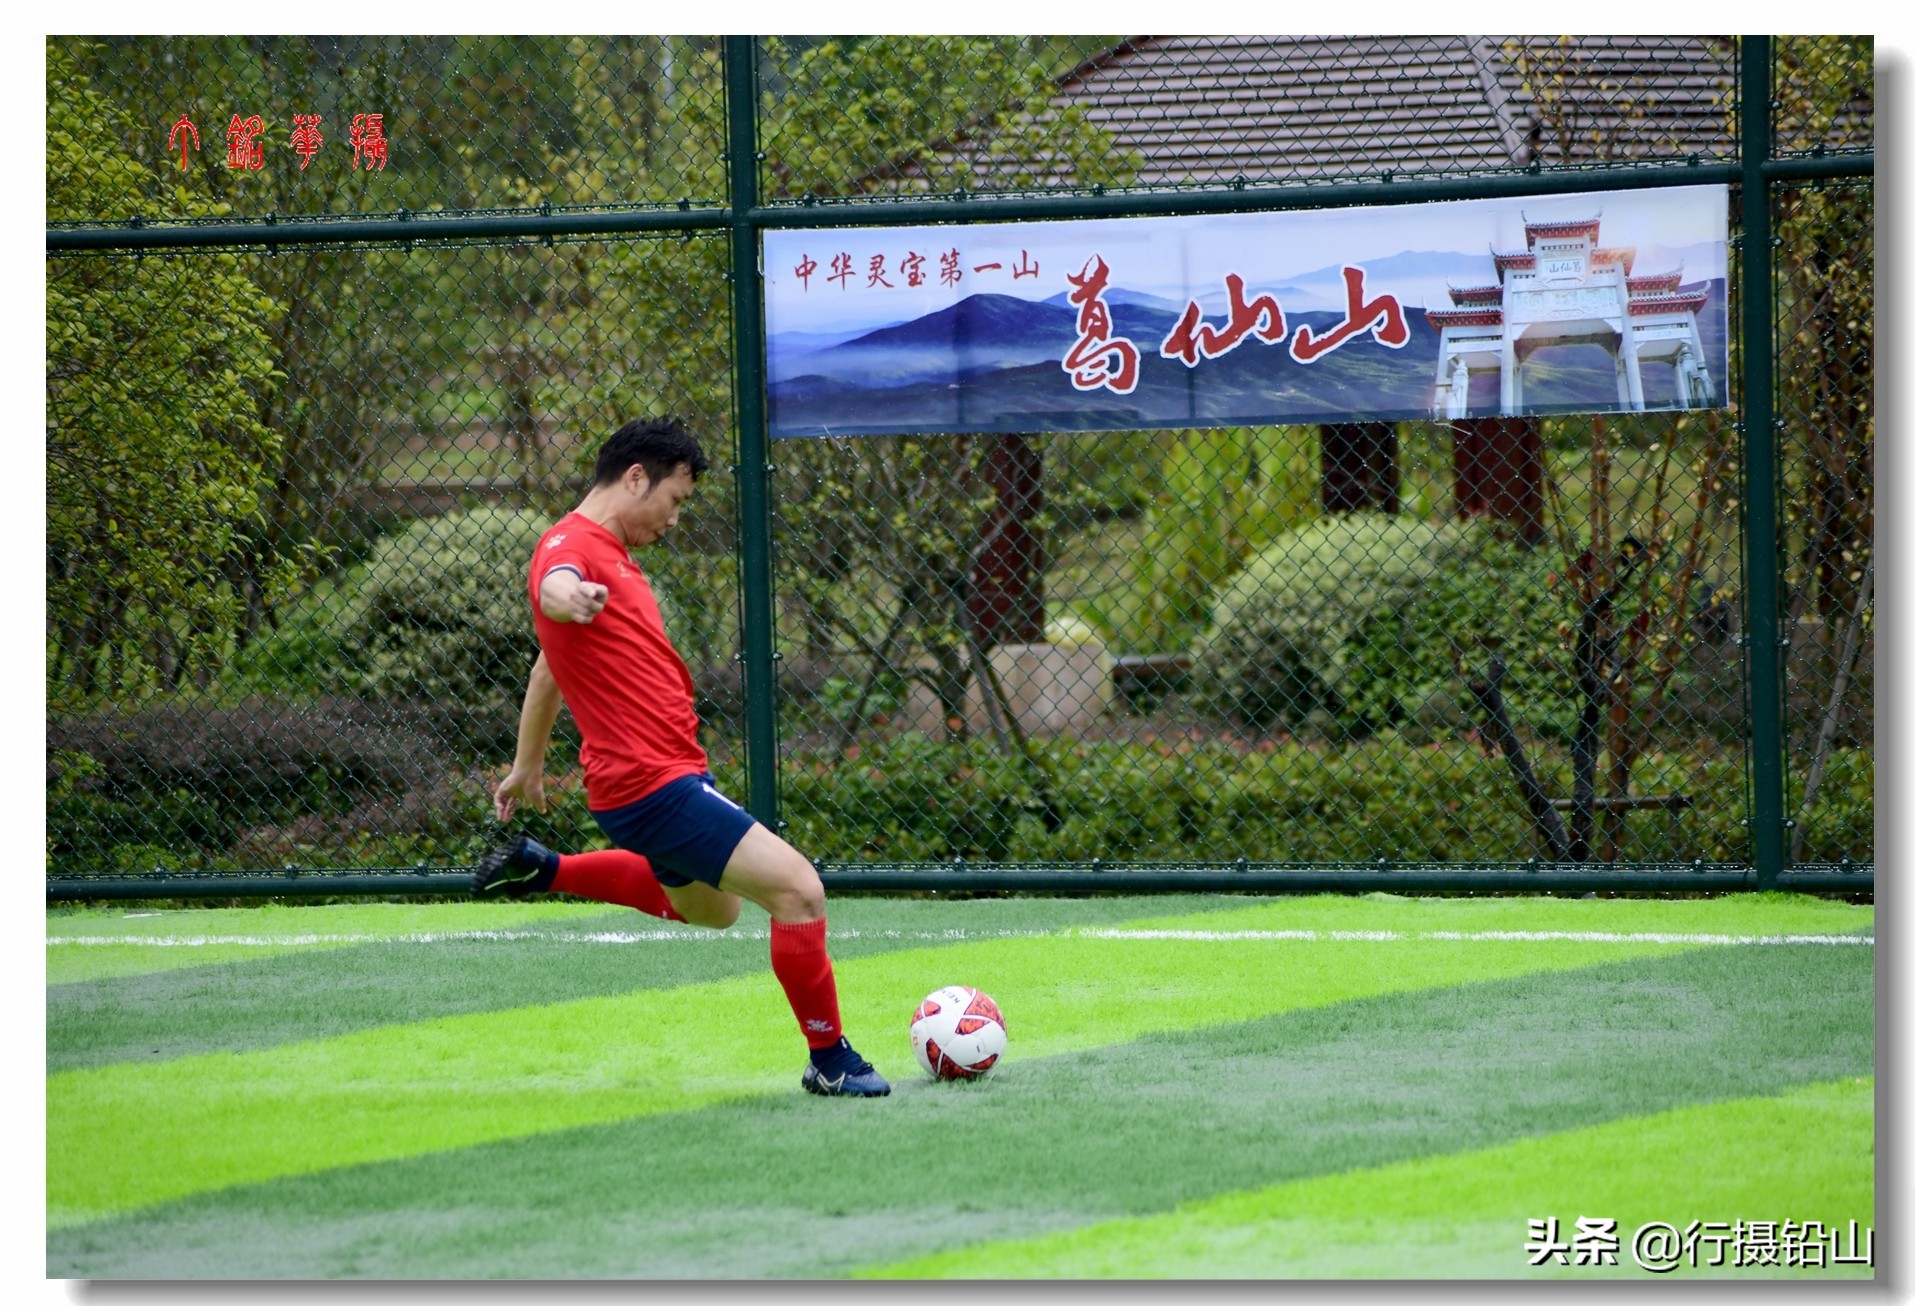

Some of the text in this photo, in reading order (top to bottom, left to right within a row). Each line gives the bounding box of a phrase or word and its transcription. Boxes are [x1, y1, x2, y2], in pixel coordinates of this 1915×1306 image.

[793, 247, 1040, 293] 中华灵宝第一山
[1063, 253, 1410, 394] 葛仙山
